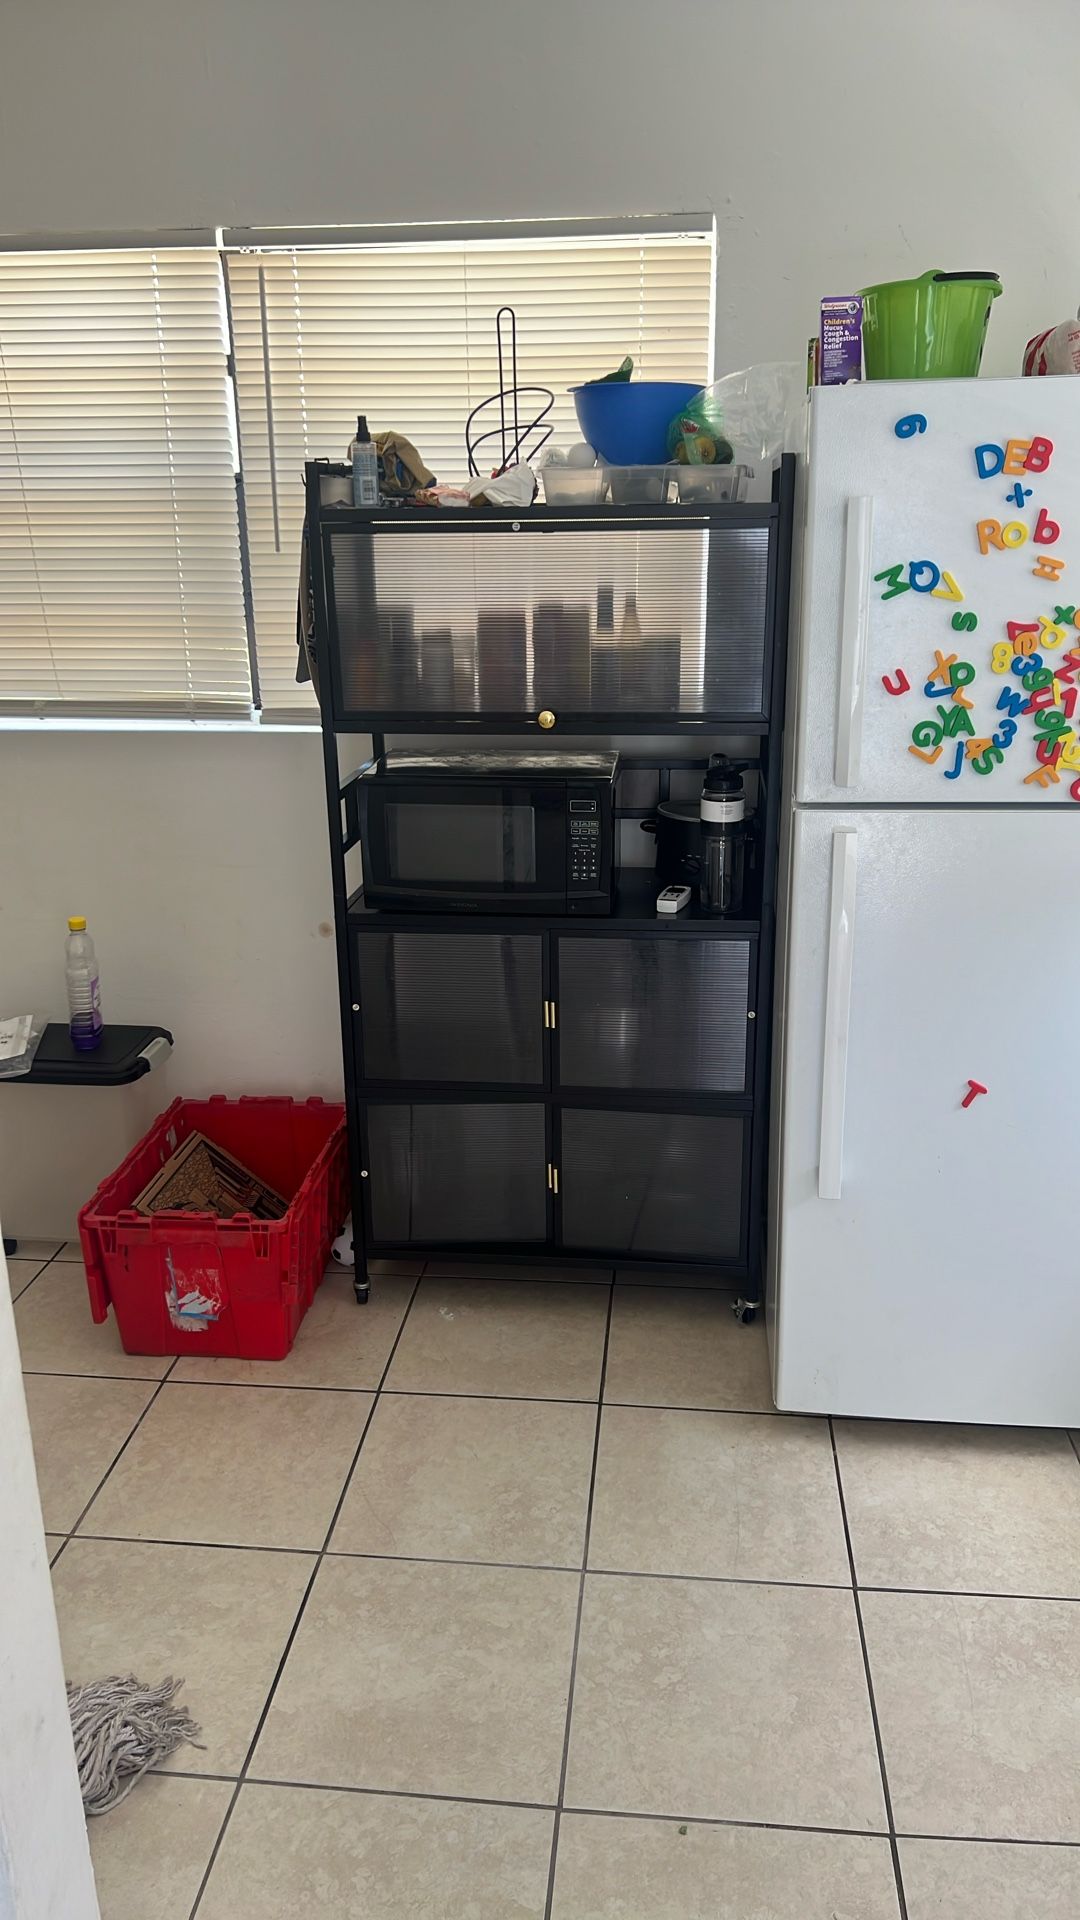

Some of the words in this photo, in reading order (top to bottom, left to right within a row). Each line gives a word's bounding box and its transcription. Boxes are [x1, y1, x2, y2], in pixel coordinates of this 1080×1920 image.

[823, 330, 844, 338] Cough
[824, 335, 859, 343] Congestion
[823, 342, 843, 350] Relief
[975, 437, 1053, 479] DEB
[961, 1080, 988, 1108] T
